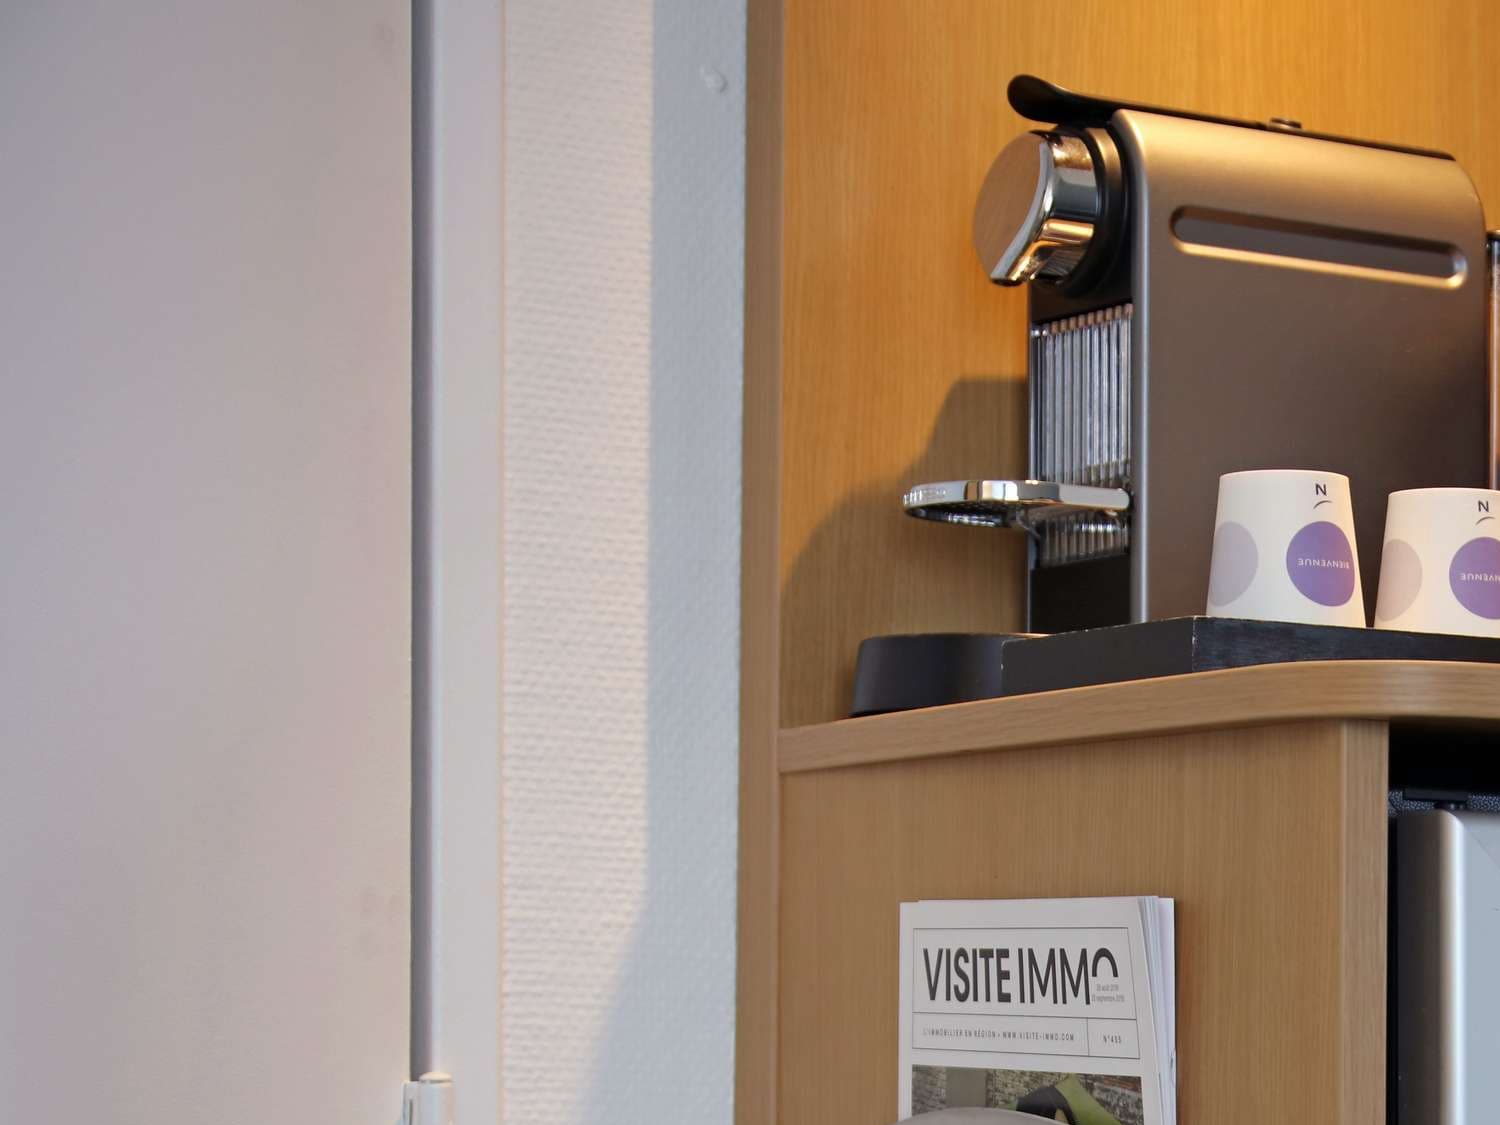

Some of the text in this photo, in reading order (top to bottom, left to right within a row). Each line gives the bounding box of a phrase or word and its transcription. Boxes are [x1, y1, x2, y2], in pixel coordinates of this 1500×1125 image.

[1315, 483, 1327, 496] N
[1477, 500, 1489, 513] N
[1298, 558, 1349, 569] BIENVENUE
[922, 947, 1012, 1003] VISITE
